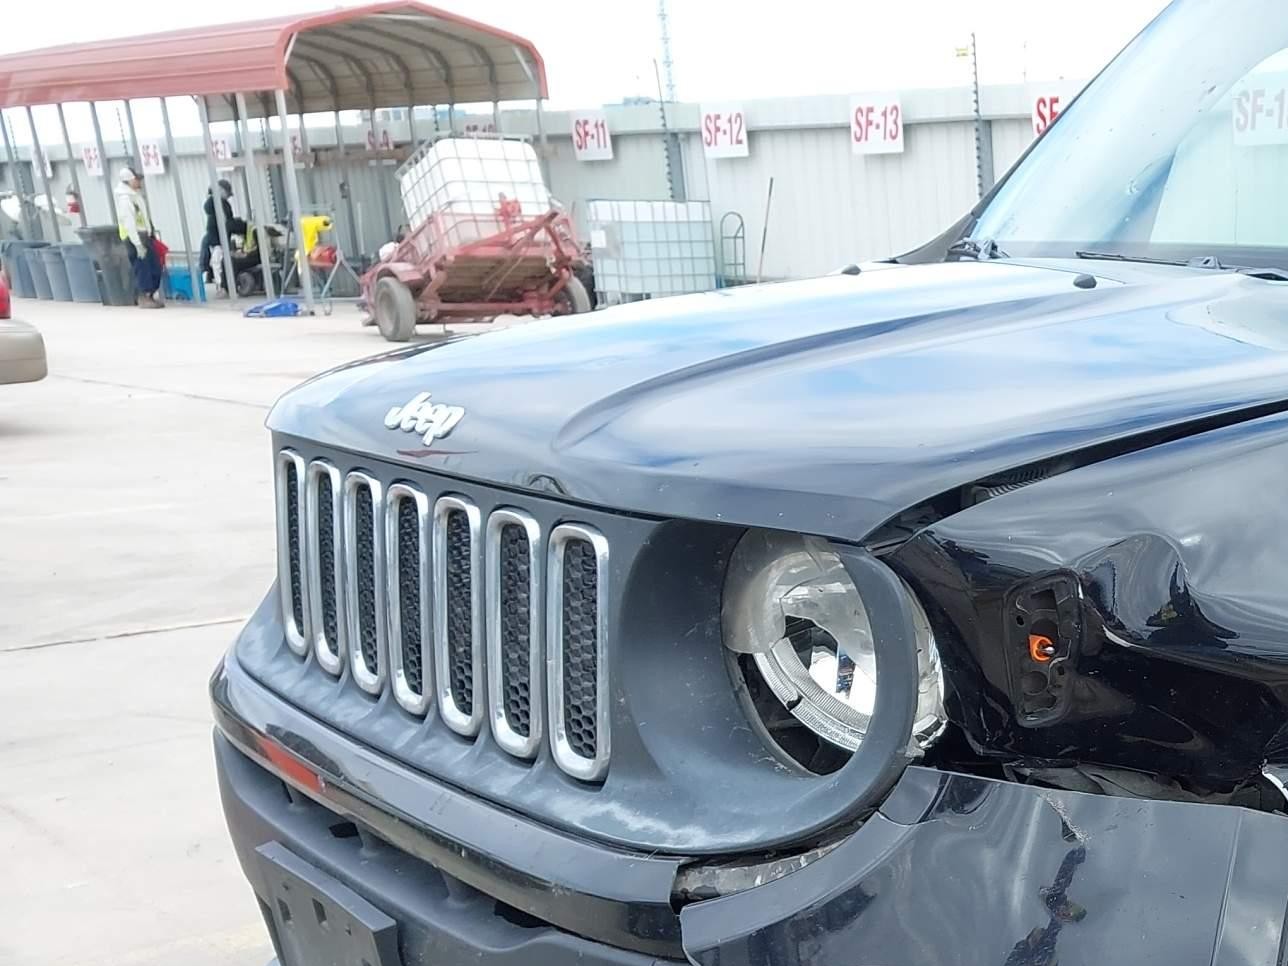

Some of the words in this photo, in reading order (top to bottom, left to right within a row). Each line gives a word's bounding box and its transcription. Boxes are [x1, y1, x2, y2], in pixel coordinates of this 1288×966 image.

[575, 119, 607, 150] SF-11
[704, 112, 743, 147] SF-12
[854, 105, 899, 142] SF-13
